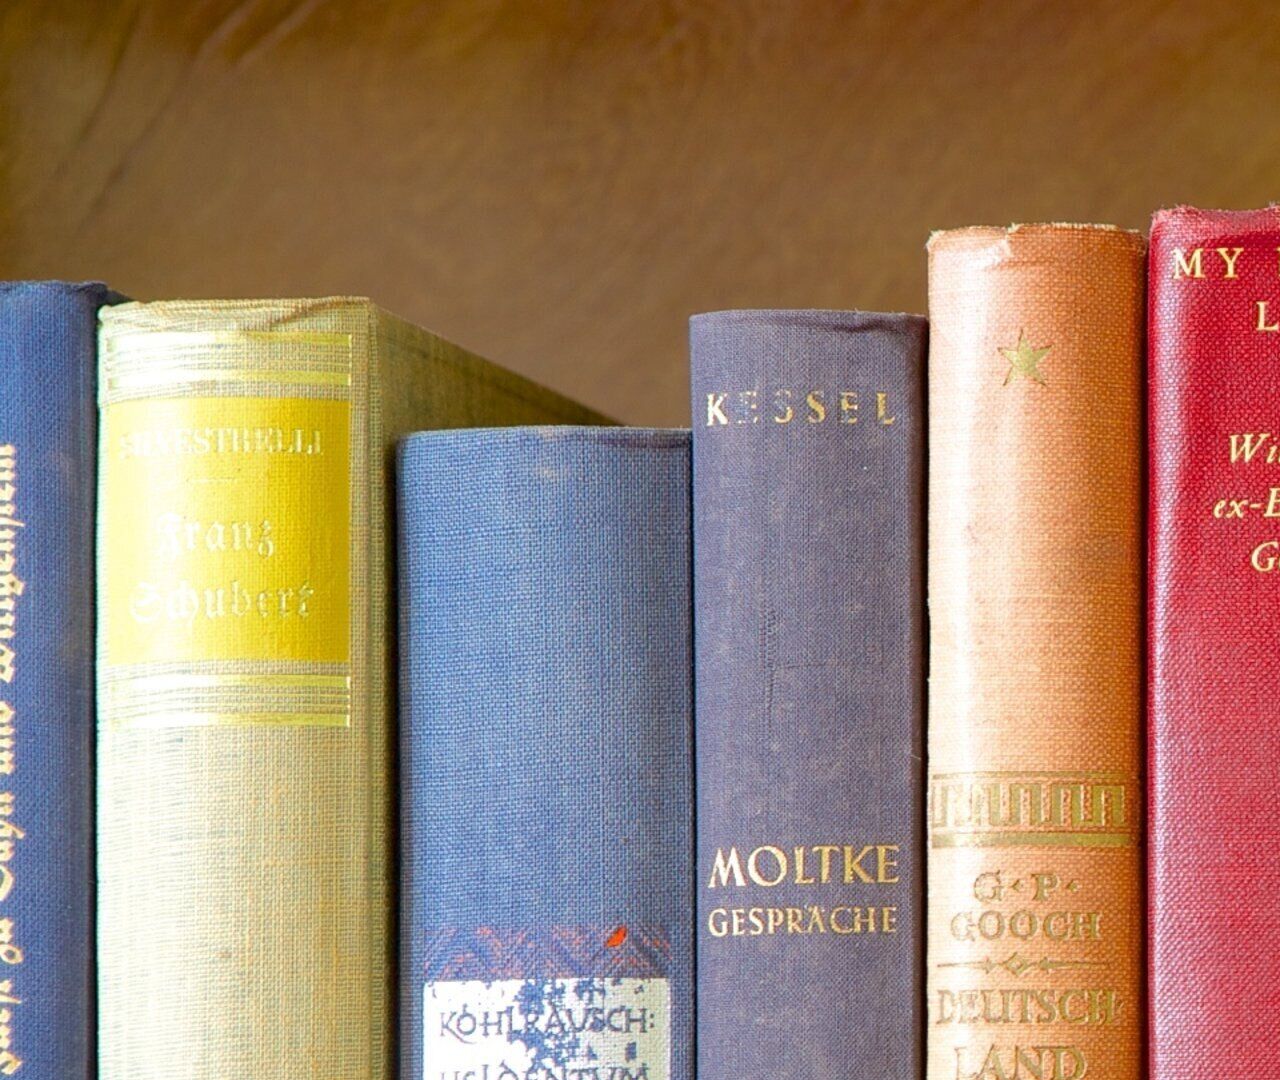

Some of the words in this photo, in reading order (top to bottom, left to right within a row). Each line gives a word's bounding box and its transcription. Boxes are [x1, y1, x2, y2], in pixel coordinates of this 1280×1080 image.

[1174, 247, 1244, 280] MY
[706, 389, 897, 426] KESSEL
[706, 845, 900, 889] MOLTKE
[707, 905, 898, 937] GESPRÄCHE
[950, 909, 1101, 942] GOOCH
